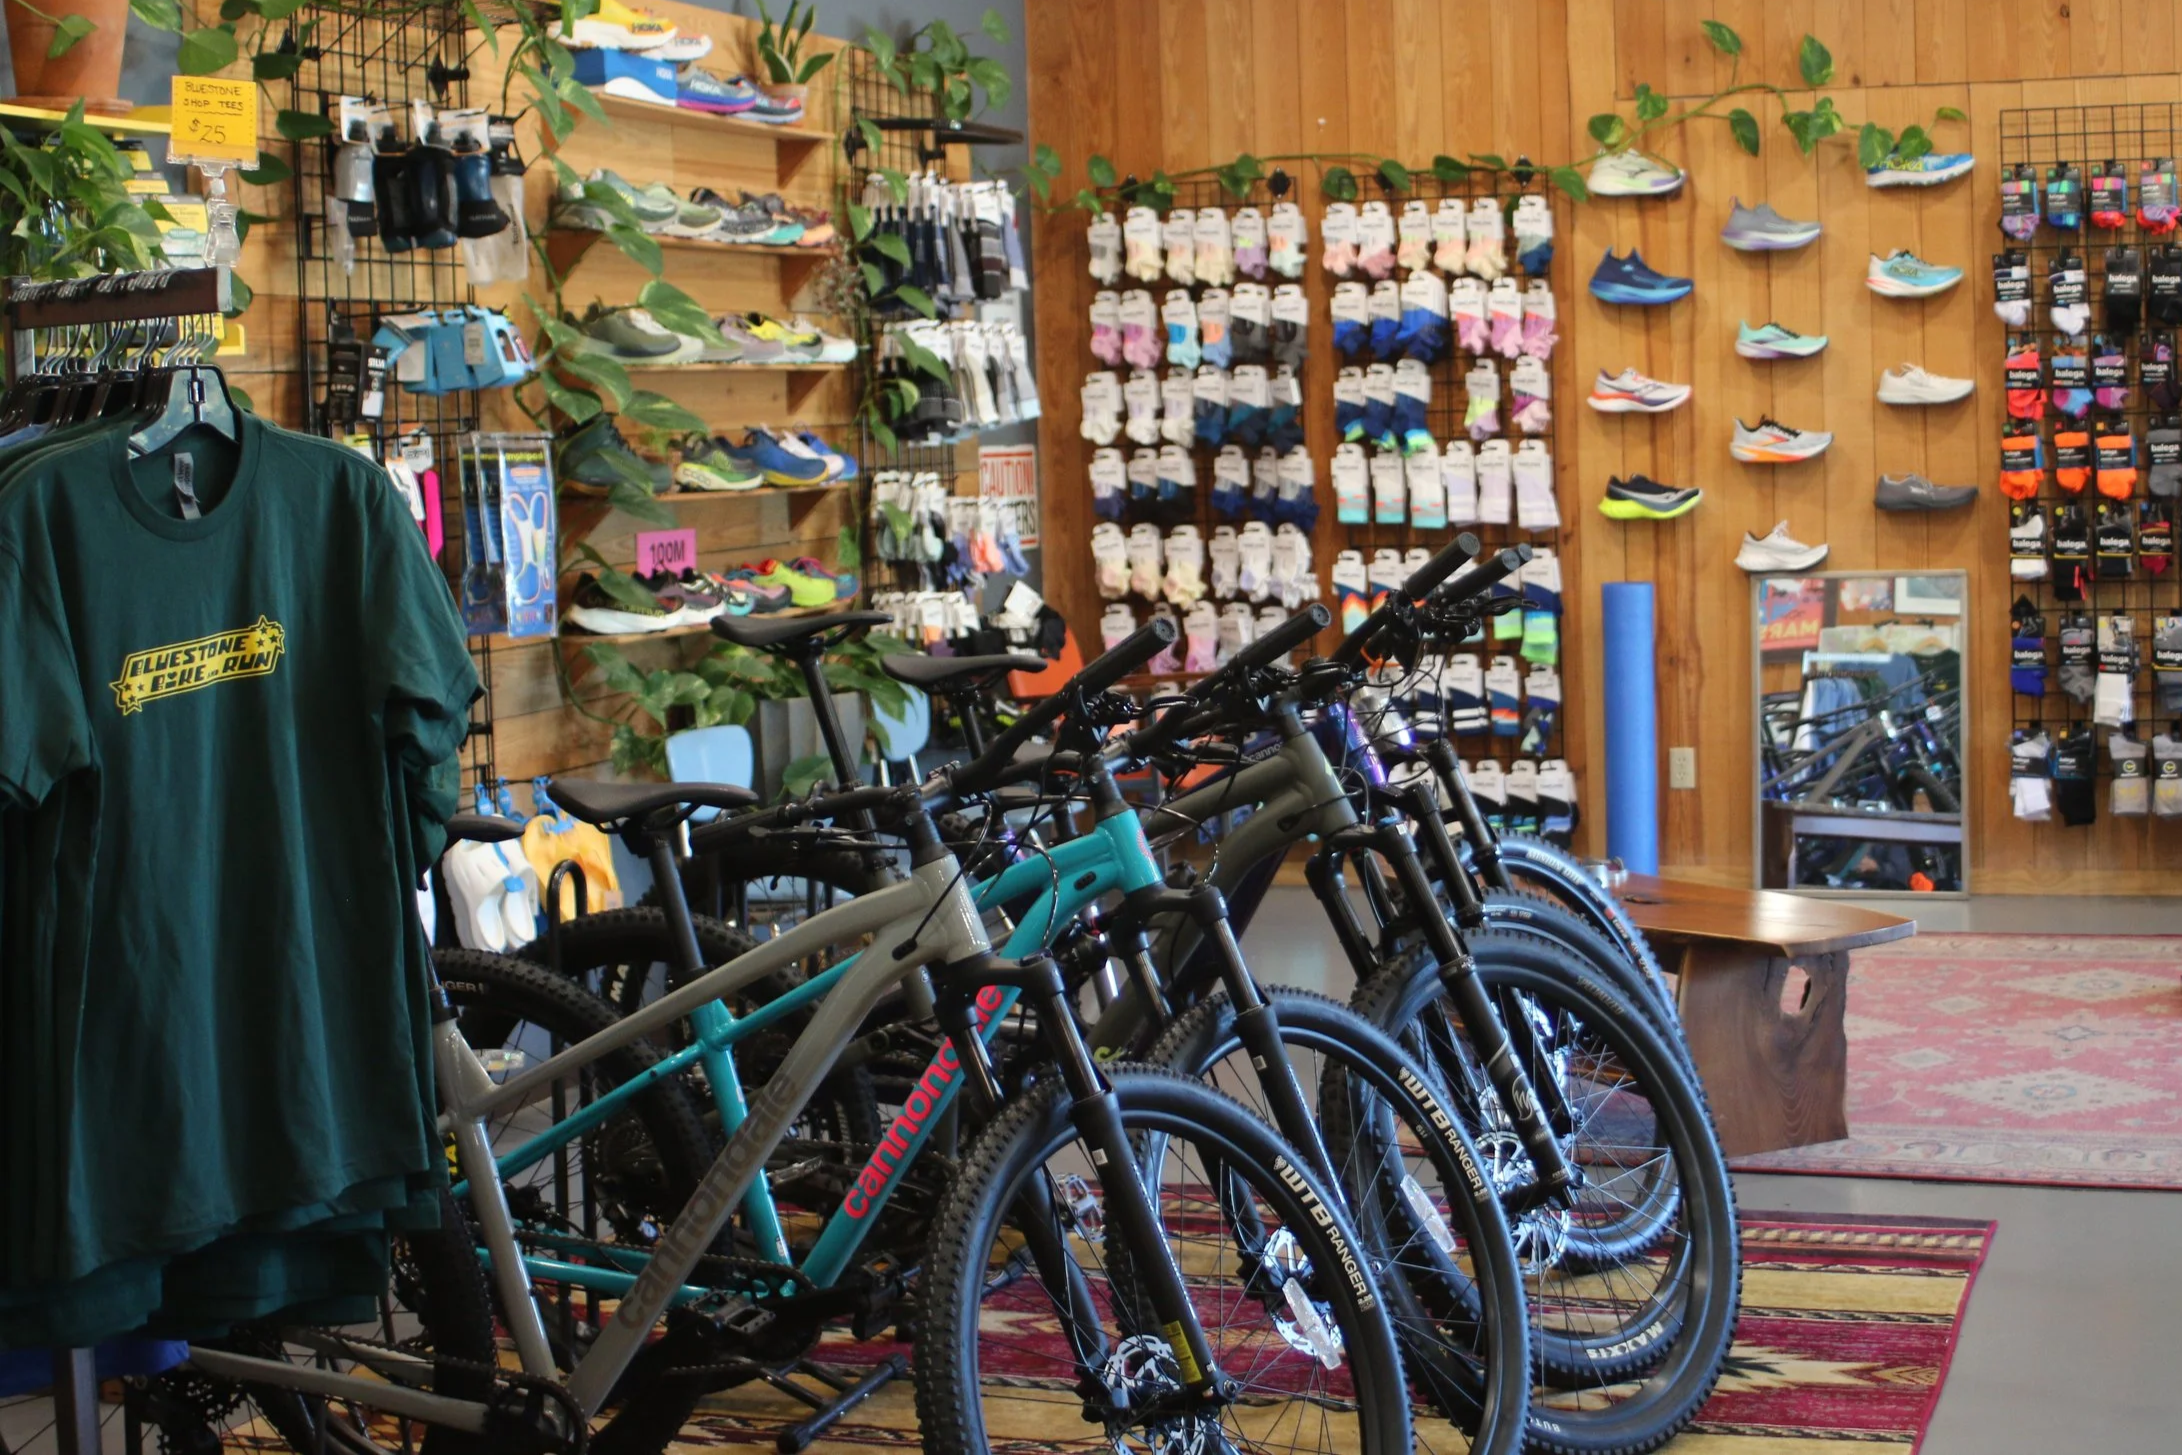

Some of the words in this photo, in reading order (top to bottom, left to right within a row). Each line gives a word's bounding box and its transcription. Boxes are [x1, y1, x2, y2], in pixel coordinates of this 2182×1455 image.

[185, 81, 241, 96] BLUESTONE
[183, 98, 210, 108] SHOP
[218, 100, 244, 111] TEES
[188, 118, 226, 144] $25
[2109, 274, 2137, 283] balega
[2152, 275, 2181, 284] balega
[1997, 280, 2026, 290] balega
[2053, 284, 2082, 293] balega
[368, 357, 386, 368] SILVA
[2141, 363, 2168, 372] balega
[2009, 370, 2037, 380] balega
[2055, 369, 2085, 378] balega
[2096, 367, 2124, 377] balega
[2151, 444, 2180, 452] balega
[2012, 539, 2042, 549] balega
[2056, 540, 2087, 549] balega
[2100, 537, 2130, 547] balega
[2142, 536, 2171, 546] balega
[650, 540, 685, 564] 100M
[2014, 651, 2044, 660] balega
[2063, 646, 2092, 656] balega
[129, 635, 250, 678] BLUESTONE
[2101, 654, 2130, 664] balega
[150, 664, 207, 693] BIKE
[222, 651, 271, 674] RUN
[1250, 742, 1282, 762] canno
[441, 980, 477, 993] GER
[1577, 975, 1625, 1014] SPECIALIZED
[844, 984, 1003, 1220] cannone
[1404, 1074, 1451, 1130] WTB
[1444, 1128, 1484, 1189] RANGER
[616, 1071, 797, 1330] cannondale
[1280, 1164, 1334, 1227] WTB
[1326, 1226, 1368, 1296] RANGER
[1586, 1320, 1664, 1360] MAXXIS
[1529, 1416, 1561, 1433] BUT
